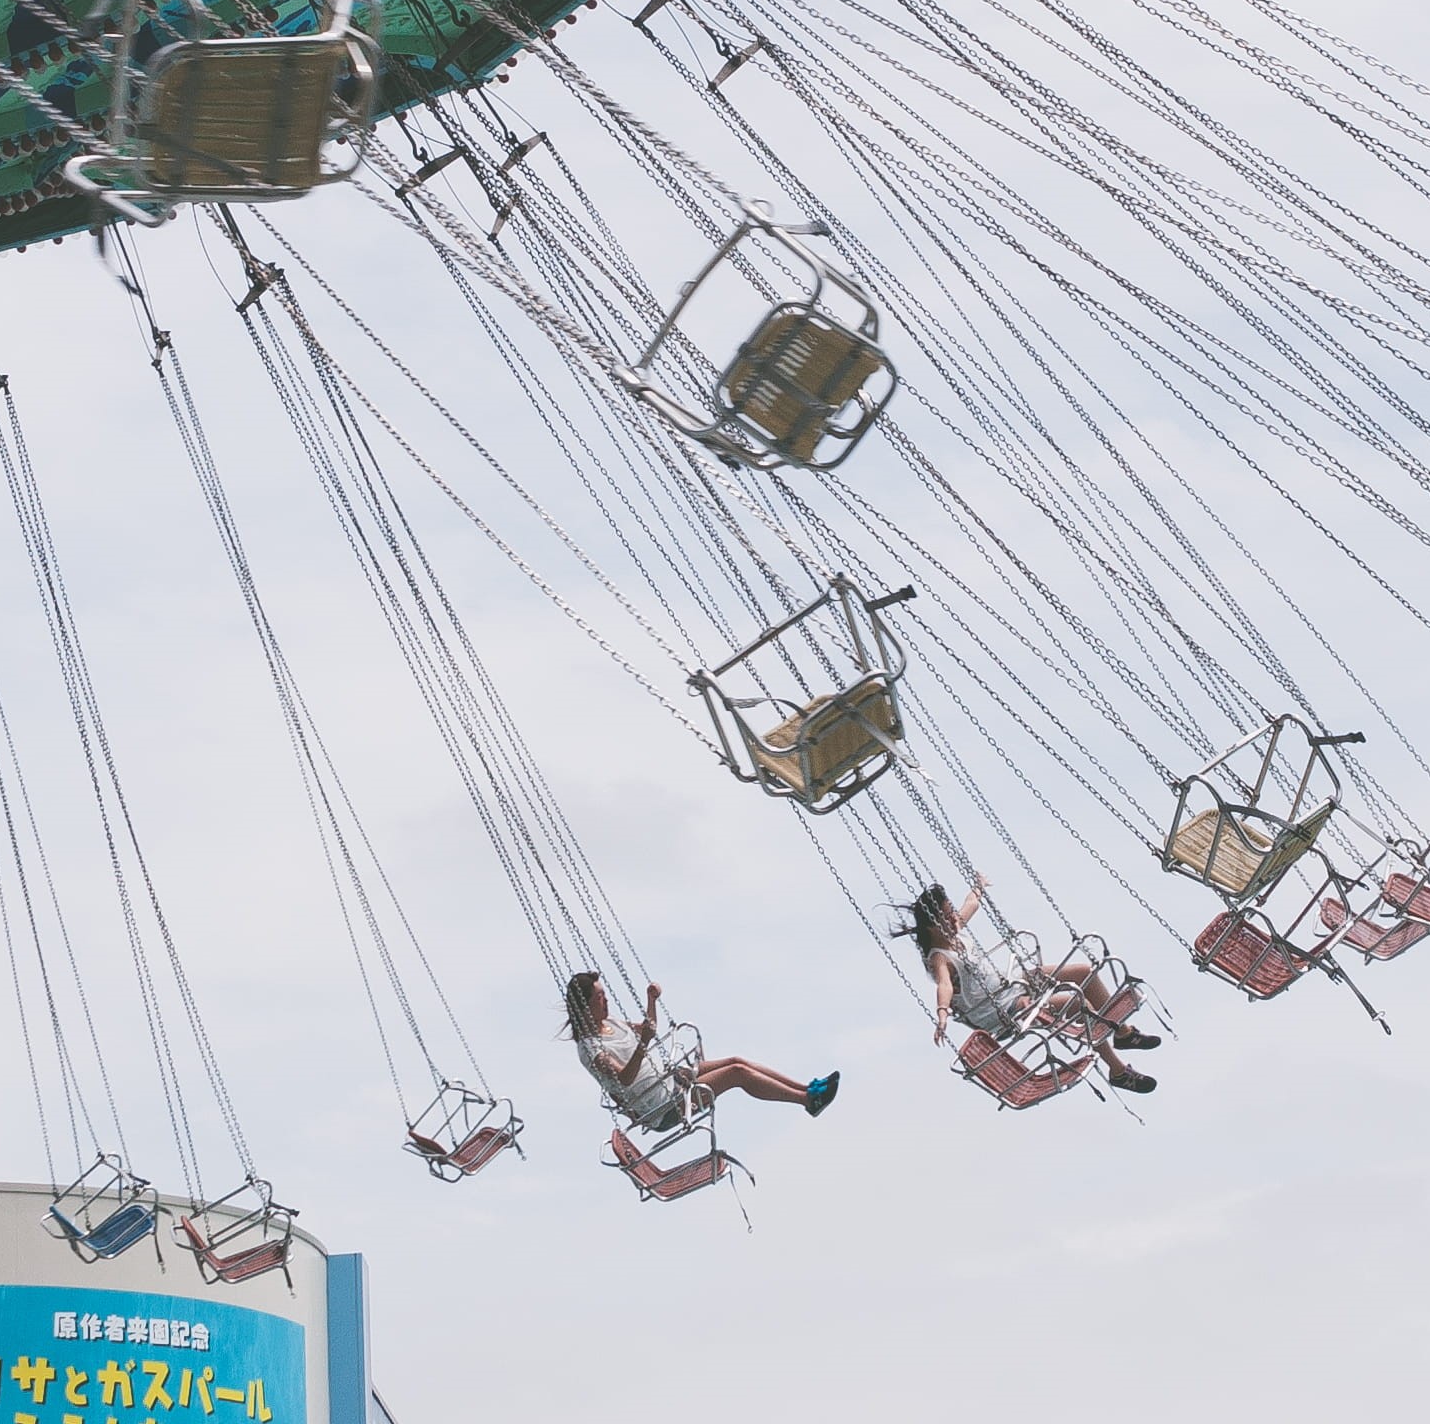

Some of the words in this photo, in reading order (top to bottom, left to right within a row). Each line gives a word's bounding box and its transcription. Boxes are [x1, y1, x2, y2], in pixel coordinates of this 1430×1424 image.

[53, 1311, 210, 1351] 原作者来園記念
